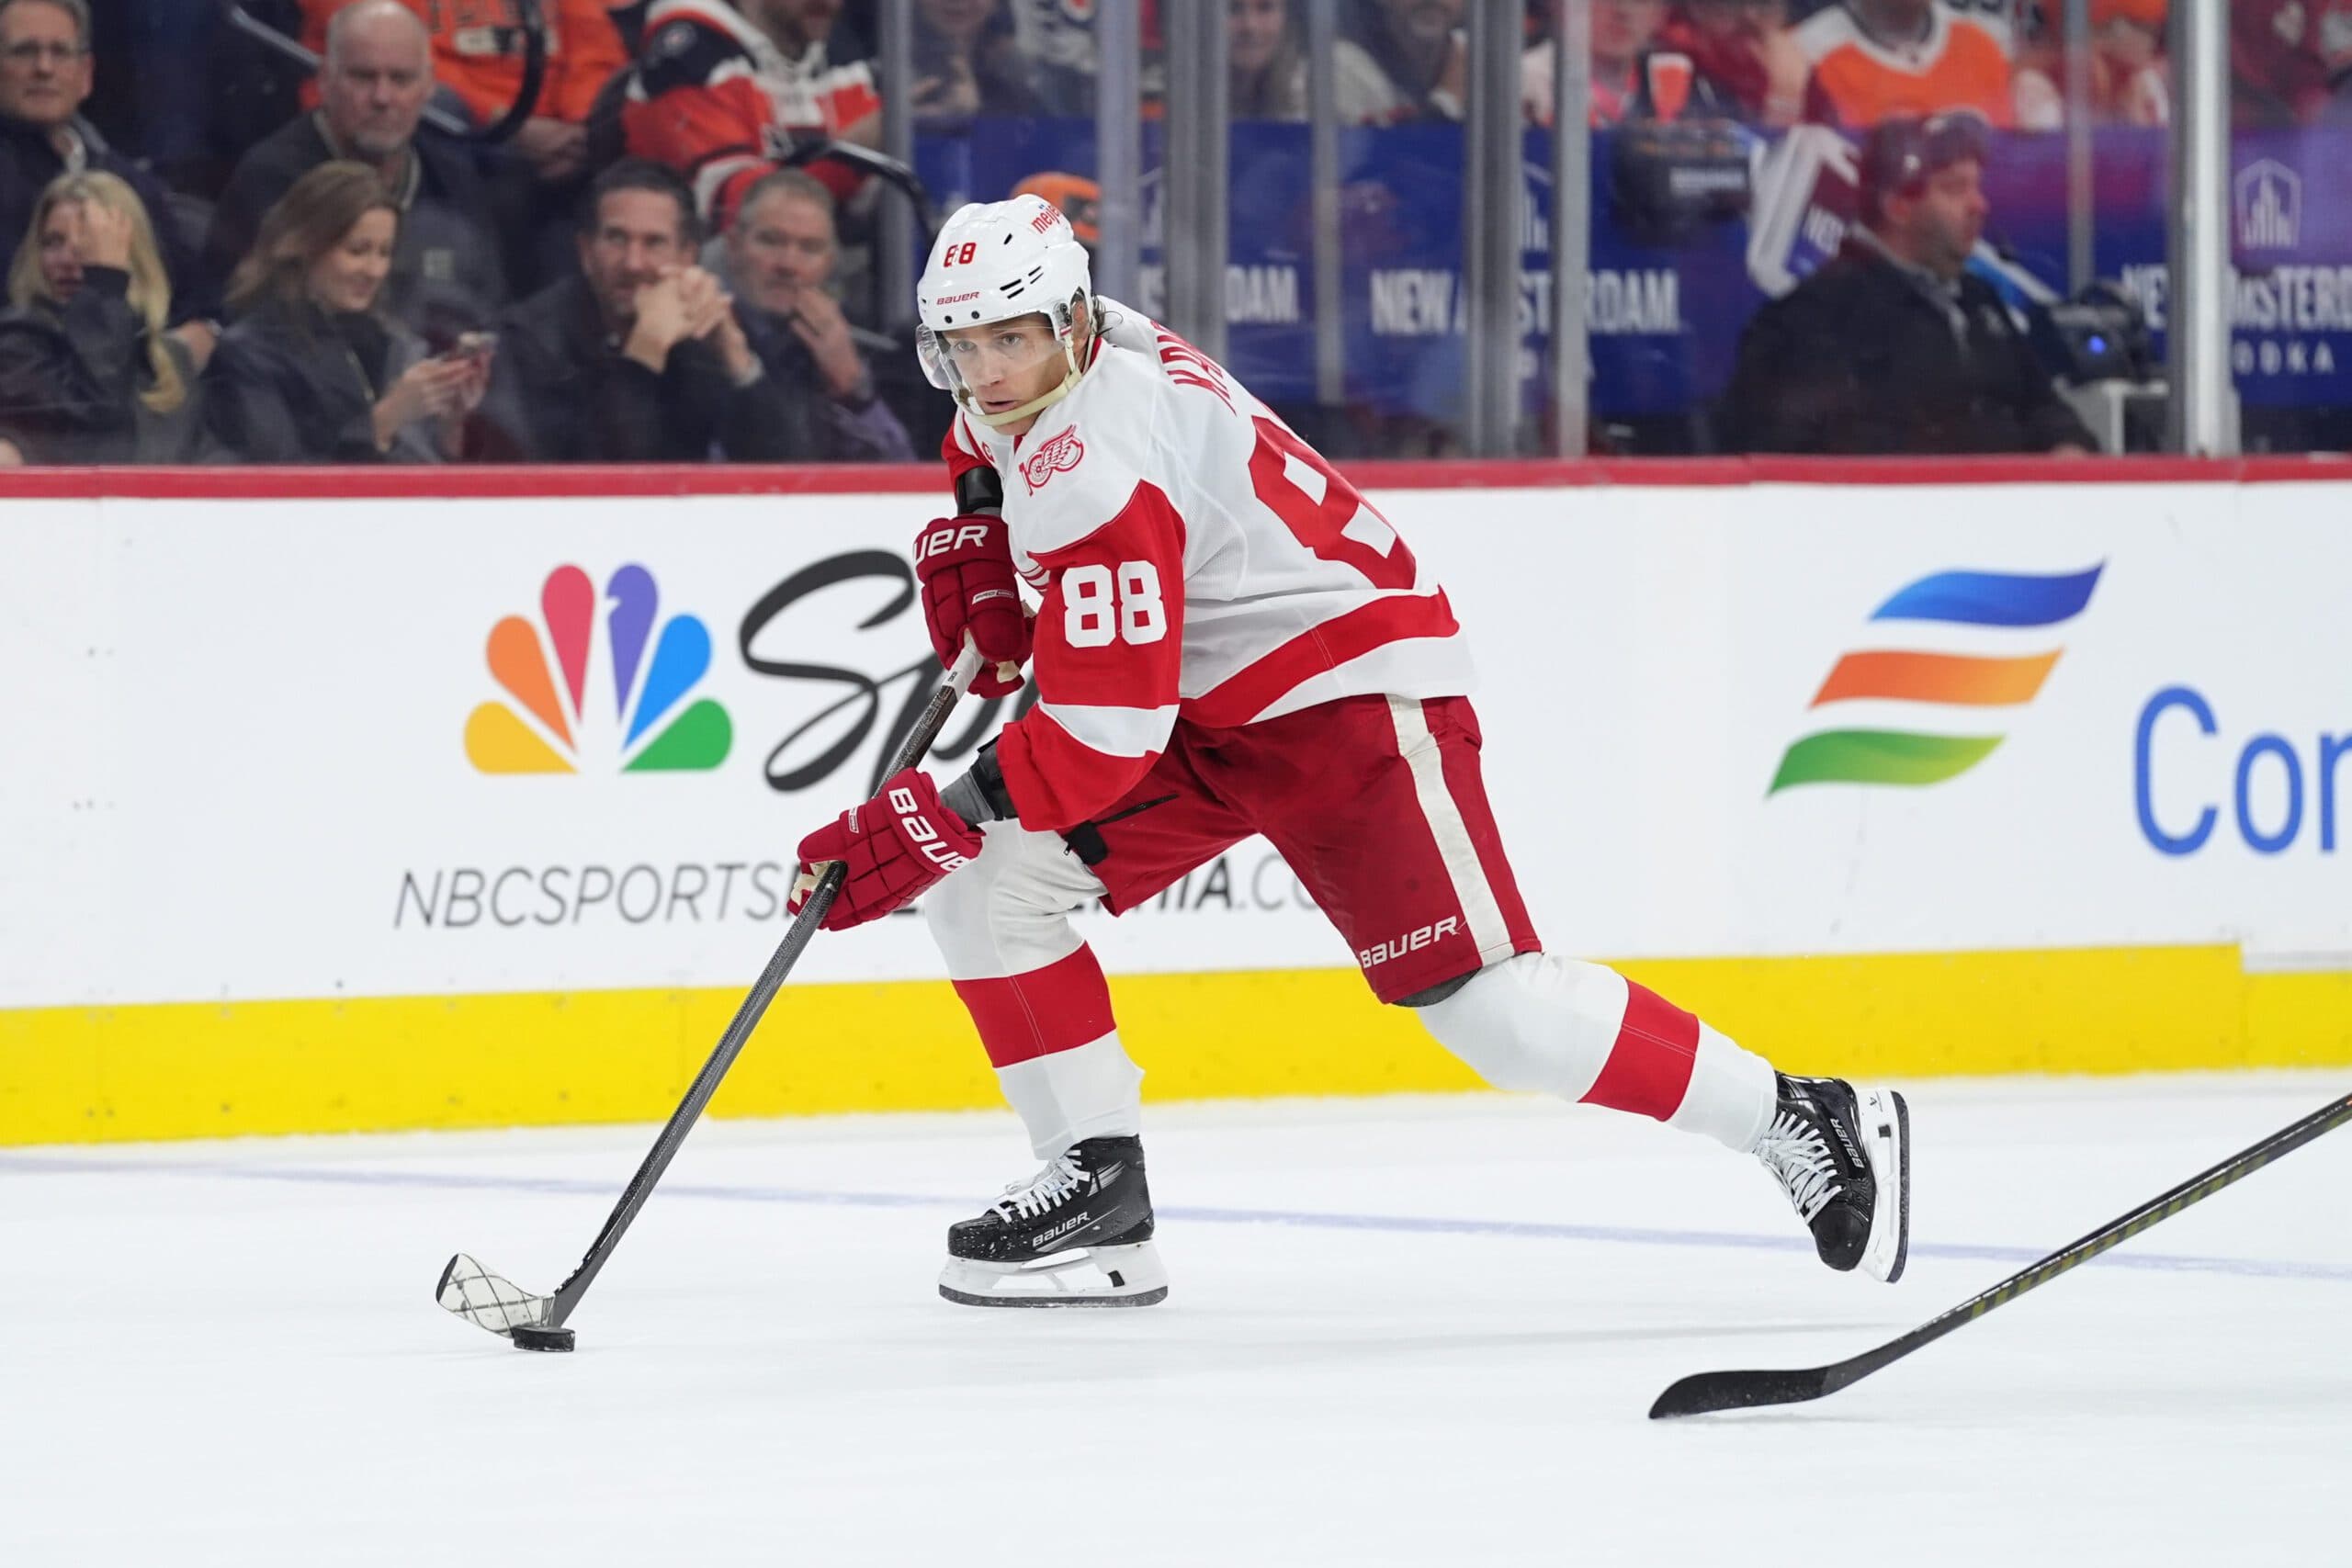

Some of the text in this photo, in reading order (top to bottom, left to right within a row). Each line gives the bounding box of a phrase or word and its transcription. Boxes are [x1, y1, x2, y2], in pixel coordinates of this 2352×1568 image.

[936, 291, 980, 305] BAUER
[1371, 270, 1453, 334] NEW
[2233, 341, 2336, 375] ODKA
[912, 525, 989, 563] UER
[1061, 559, 1168, 649] 88
[888, 787, 970, 872] BAUE
[1360, 915, 1460, 969] BAUER
[1032, 1211, 1091, 1247] BAUER
